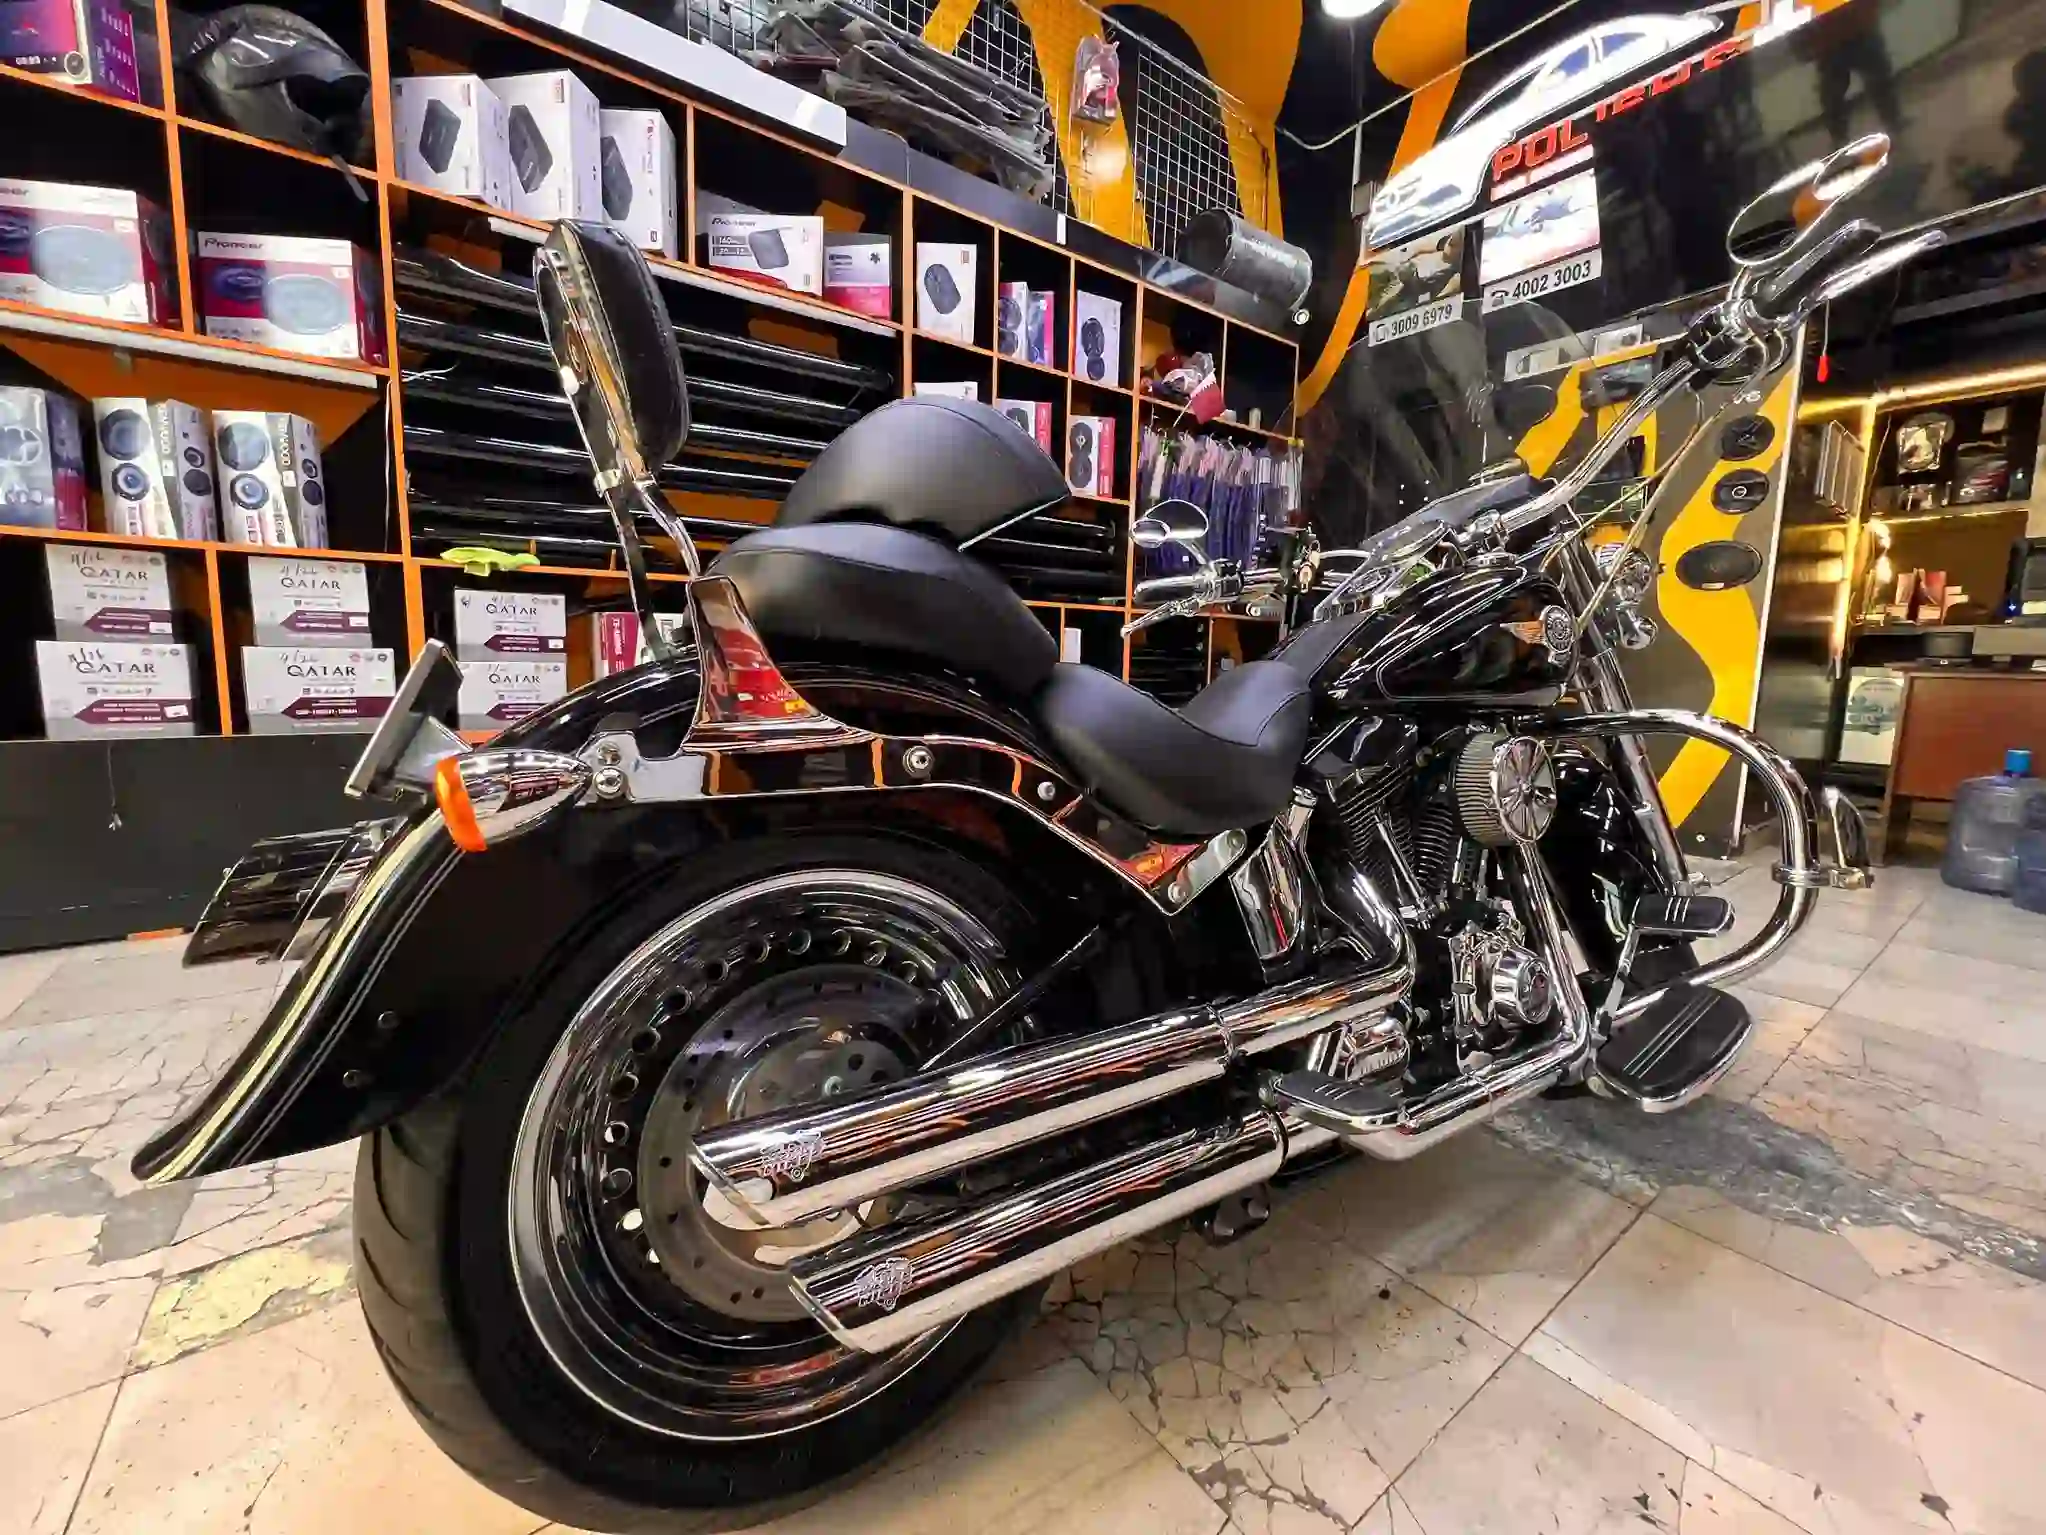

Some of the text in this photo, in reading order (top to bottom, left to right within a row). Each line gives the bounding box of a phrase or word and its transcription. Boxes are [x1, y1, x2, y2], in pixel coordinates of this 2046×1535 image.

[1512, 259, 1592, 299] 4002 3003
[1390, 304, 1453, 336] 3009 6979
[80, 566, 149, 580] QATAR
[281, 577, 341, 589] QATAR
[486, 603, 537, 615] QATAR
[76, 661, 156, 674] QATAR
[287, 664, 357, 677] QATAR
[488, 673, 541, 684] QATAR
